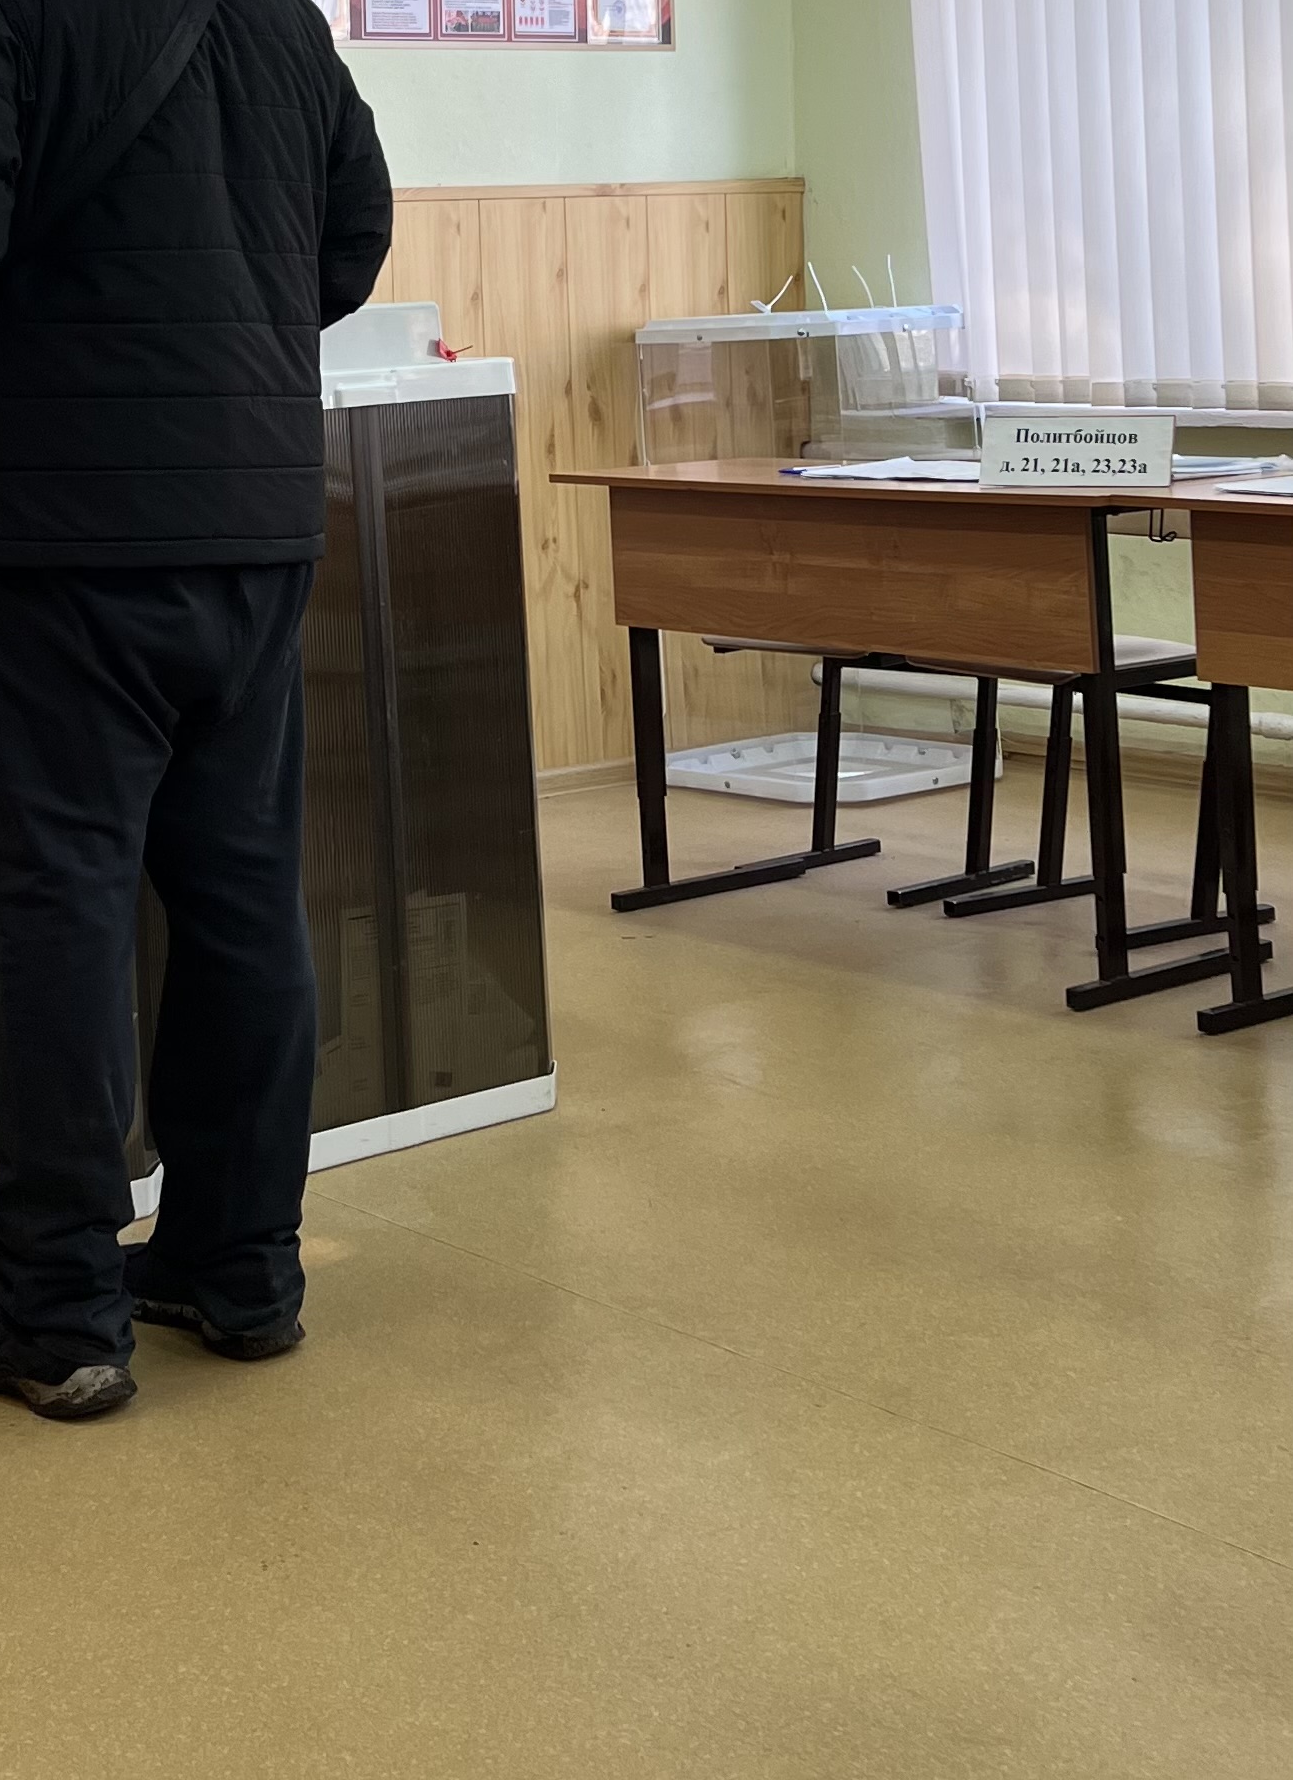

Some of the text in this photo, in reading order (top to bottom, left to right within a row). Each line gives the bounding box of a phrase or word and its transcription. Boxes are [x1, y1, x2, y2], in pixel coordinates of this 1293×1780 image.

[1016, 428, 1138, 446] Политбойцов
[999, 457, 1147, 476] д. 21, 21а, 23,23а
